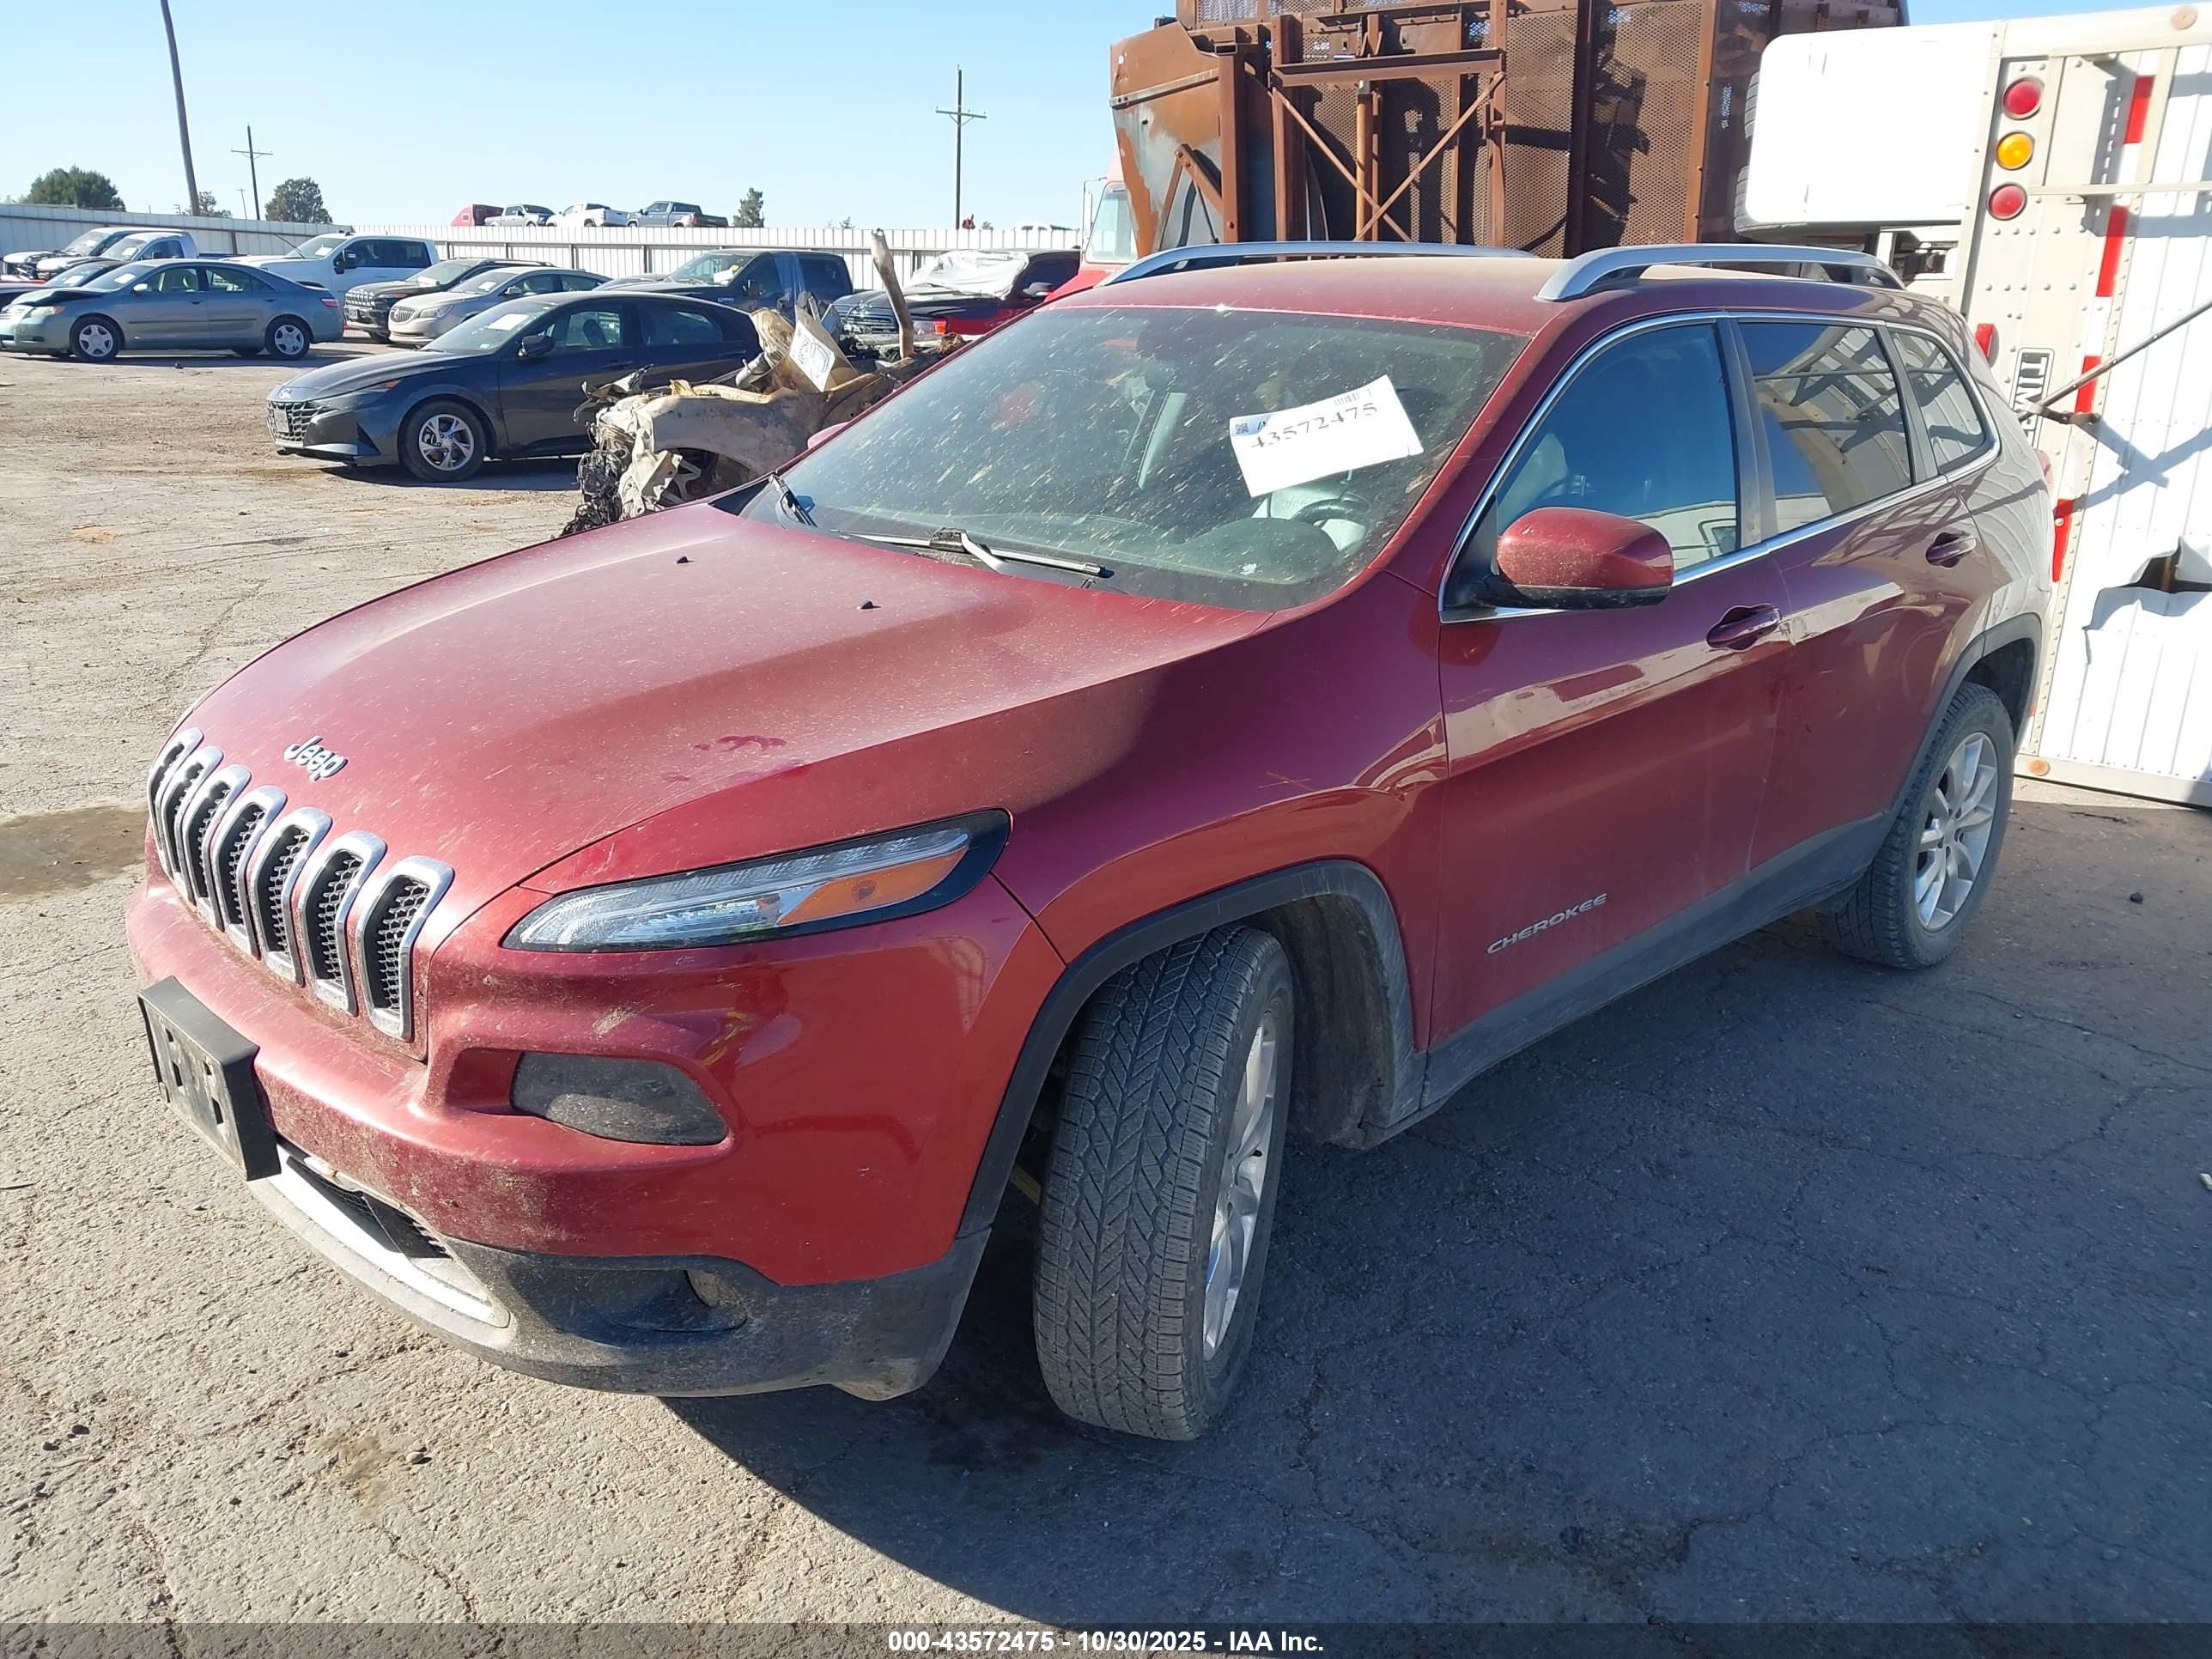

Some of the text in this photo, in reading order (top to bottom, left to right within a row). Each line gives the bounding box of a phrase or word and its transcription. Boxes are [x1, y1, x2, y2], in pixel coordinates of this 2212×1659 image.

[1251, 402, 1378, 448] 43572475
[2014, 356, 2048, 445] TIM
[283, 735, 348, 781] Jeep
[1487, 893, 1607, 954] CHEROKEE
